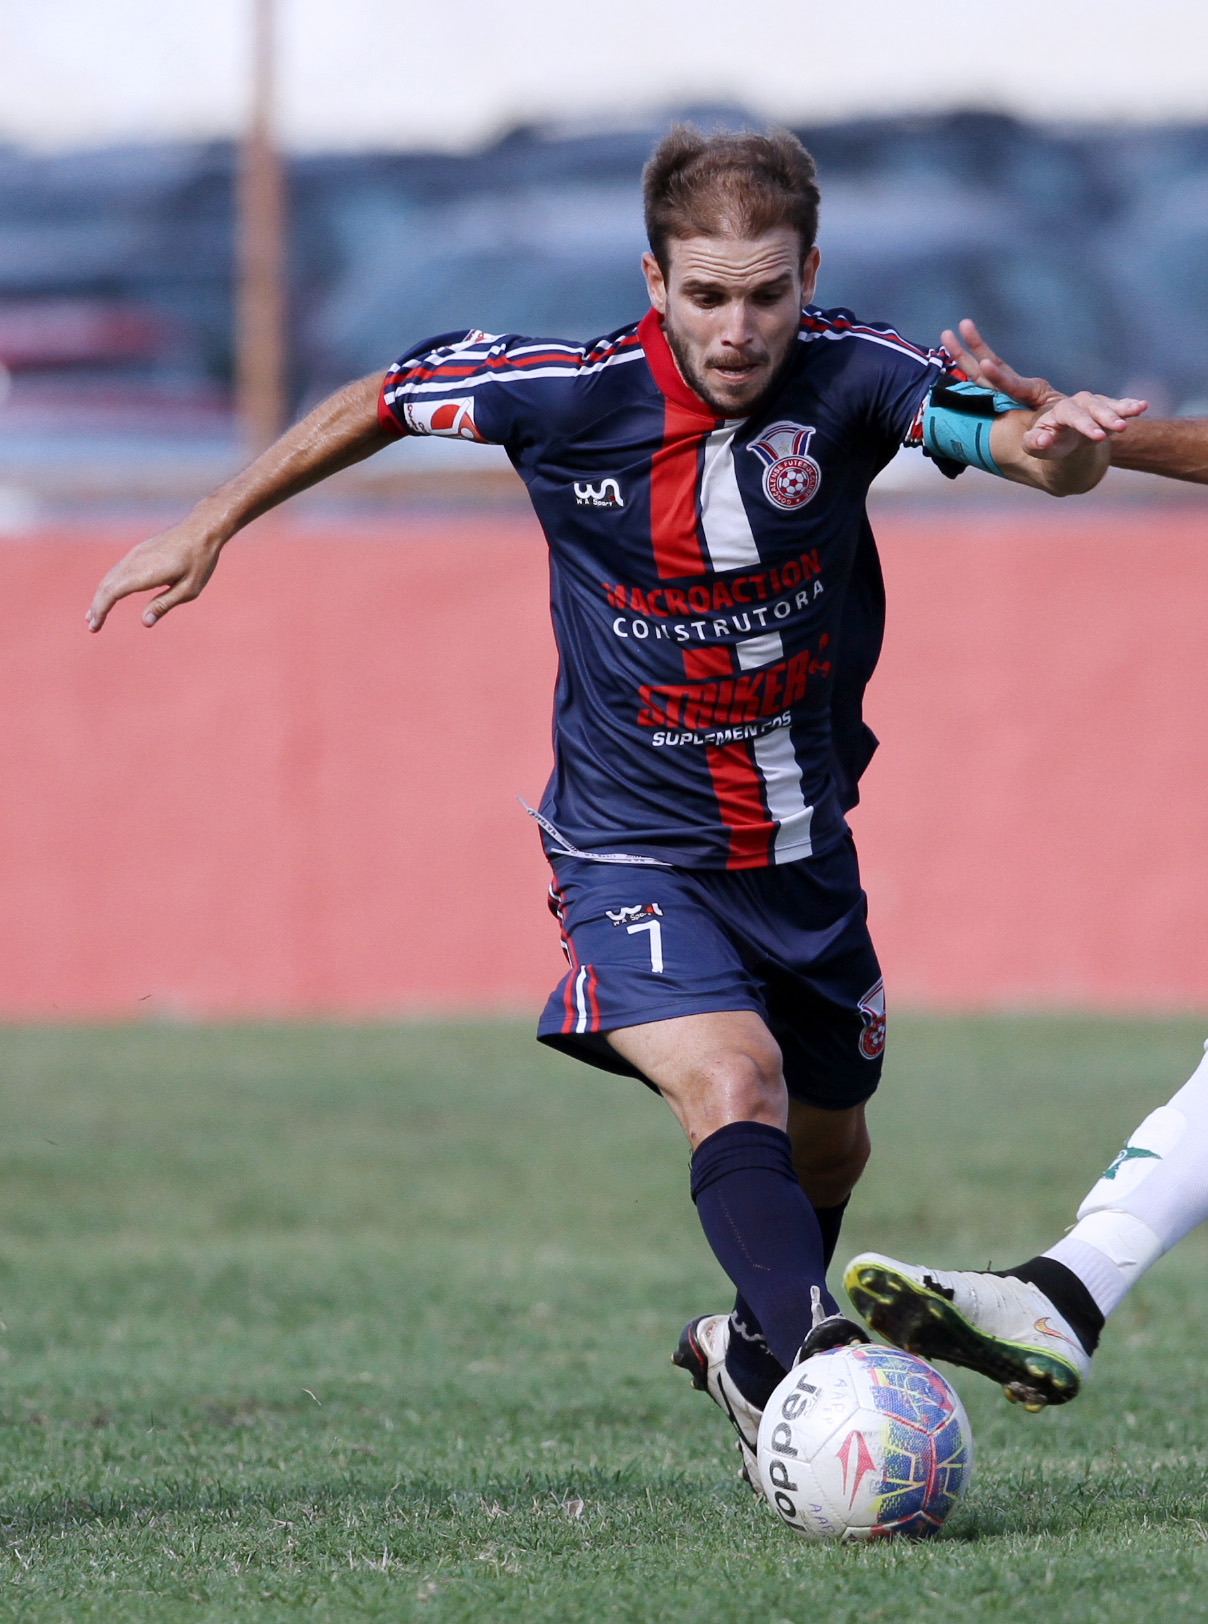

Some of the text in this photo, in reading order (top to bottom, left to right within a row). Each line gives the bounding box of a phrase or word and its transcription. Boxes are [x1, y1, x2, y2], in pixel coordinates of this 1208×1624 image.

[601, 548, 822, 618] MACROACTION
[613, 579, 825, 642] CONSTRUTORA
[637, 649, 810, 730] STRIKER
[626, 919, 664, 974] 7
